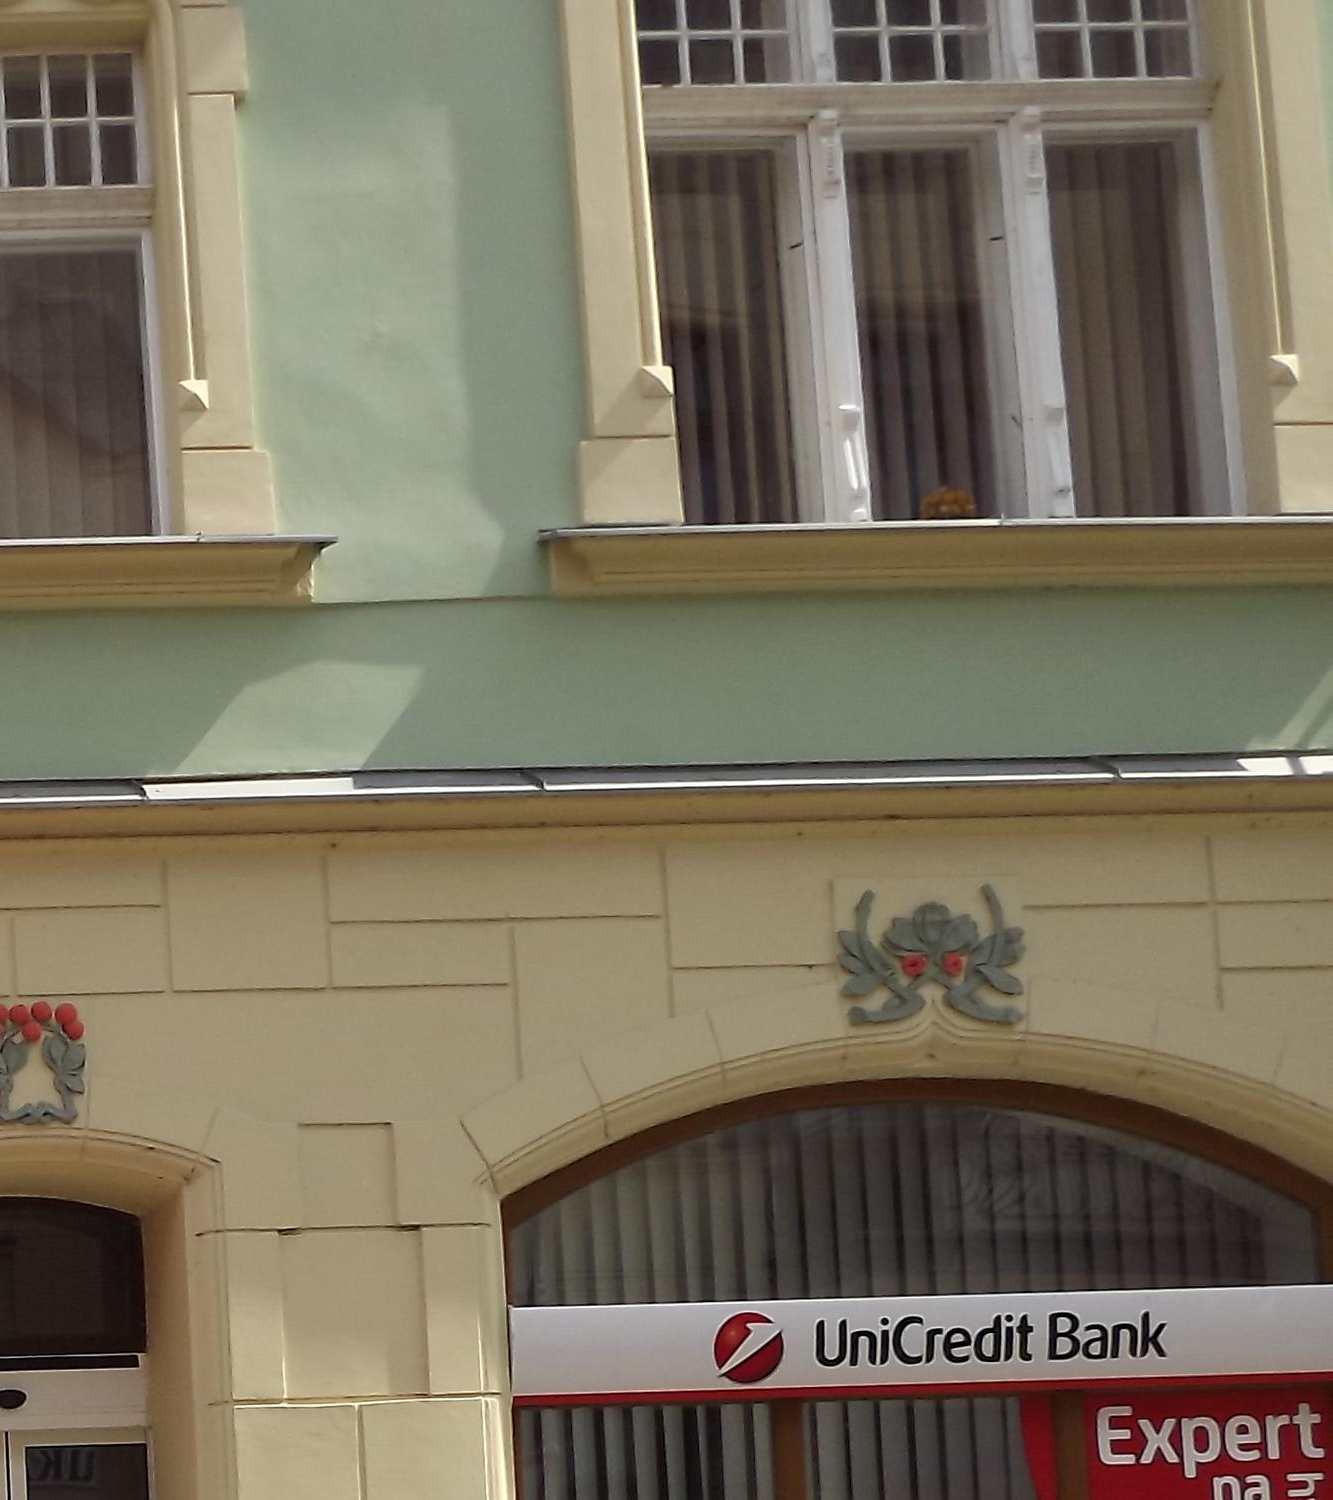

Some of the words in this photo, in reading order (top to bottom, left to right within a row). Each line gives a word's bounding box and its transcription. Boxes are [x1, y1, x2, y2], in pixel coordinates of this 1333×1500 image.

[815, 1313, 1034, 1367] UniCredit
[1047, 1310, 1168, 1361] Bank
[1096, 1402, 1326, 1479] Expert
